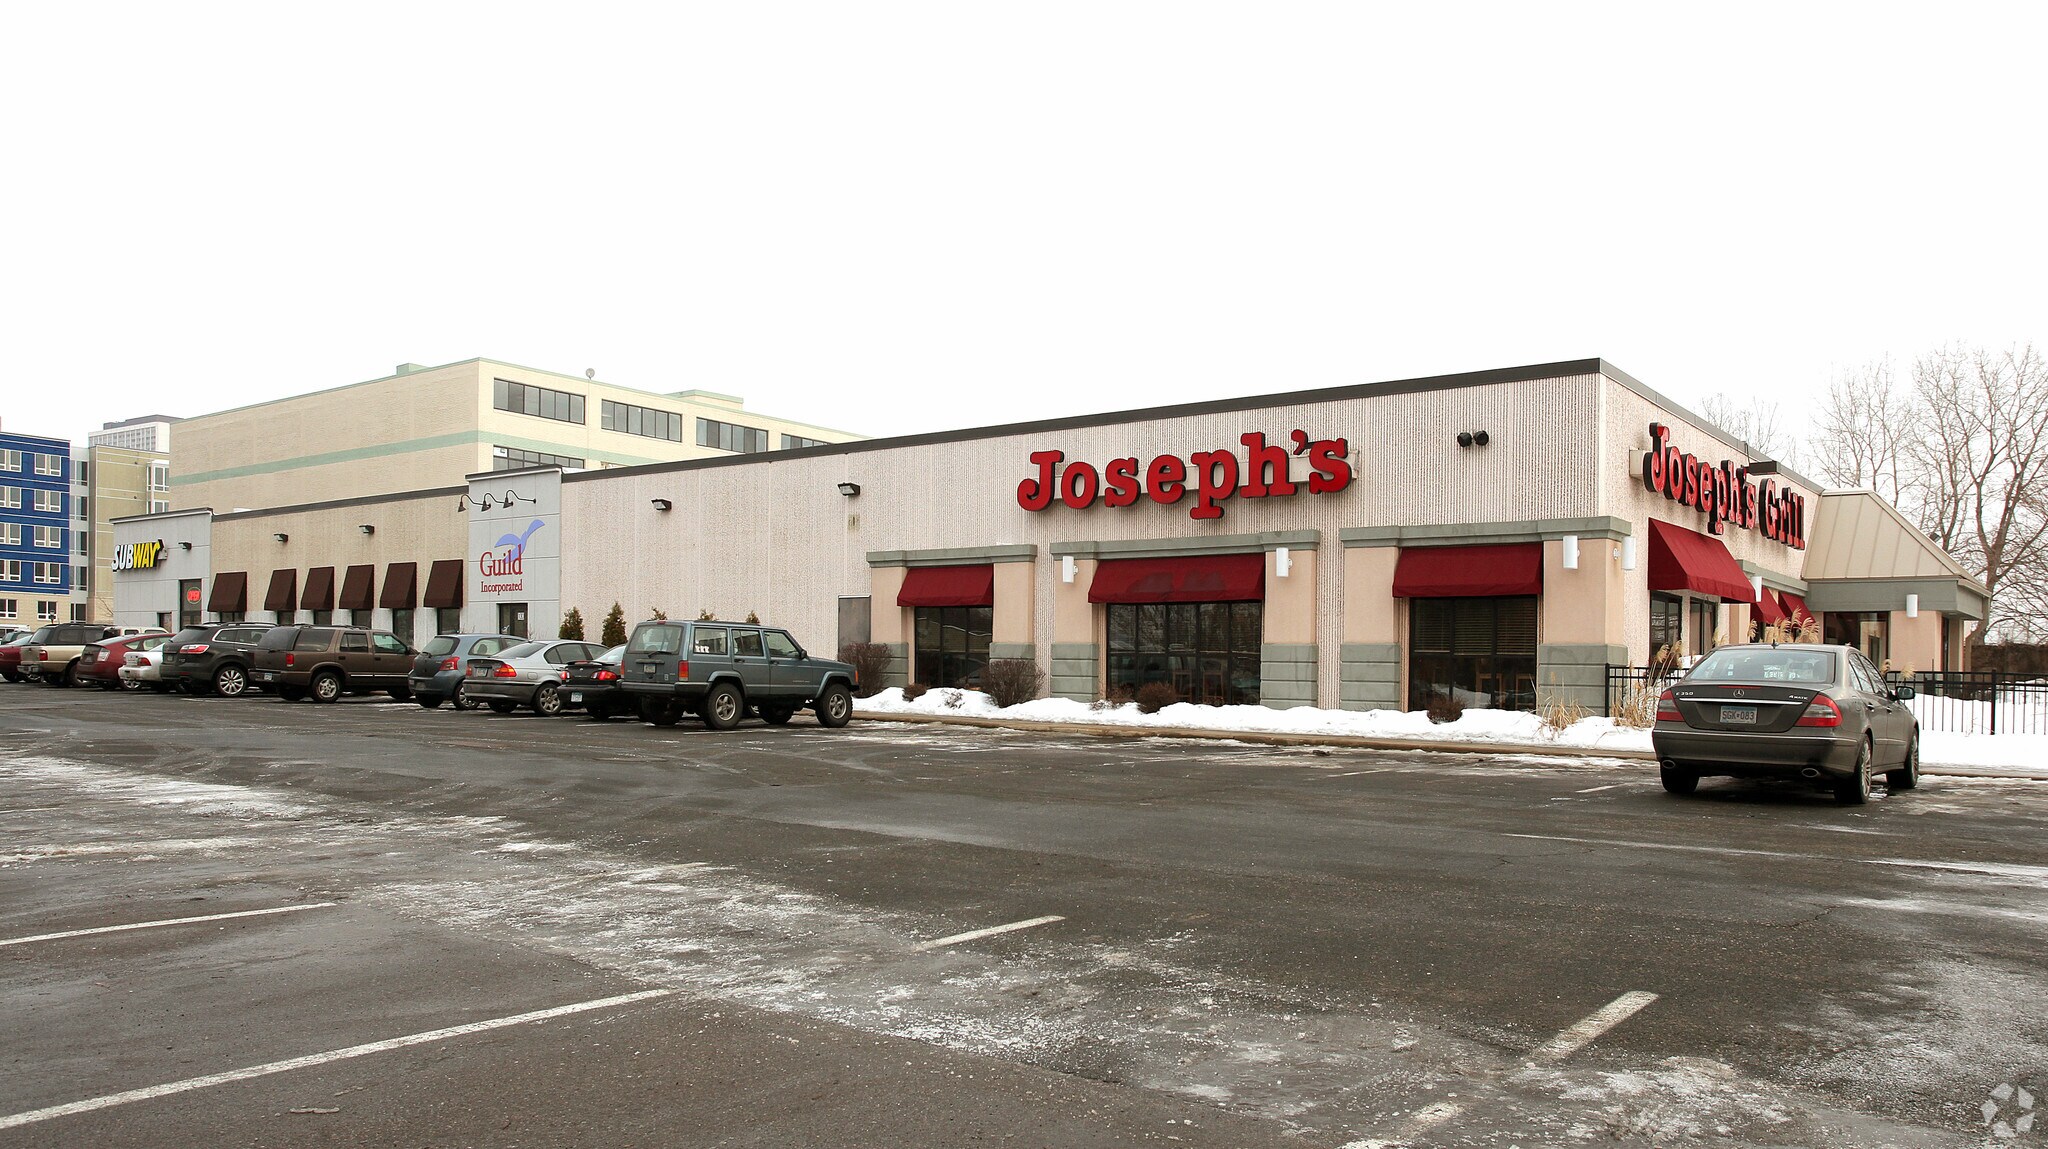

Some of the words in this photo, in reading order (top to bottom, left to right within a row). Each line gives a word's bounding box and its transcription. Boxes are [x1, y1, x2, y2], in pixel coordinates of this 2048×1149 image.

[1017, 429, 1350, 520] Joseph's
[1643, 422, 1757, 535] Joseph's
[1759, 477, 1805, 550] Grill
[111, 540, 163, 571] SUBWAY
[480, 544, 523, 577] Guild
[480, 579, 523, 595] Incorporated
